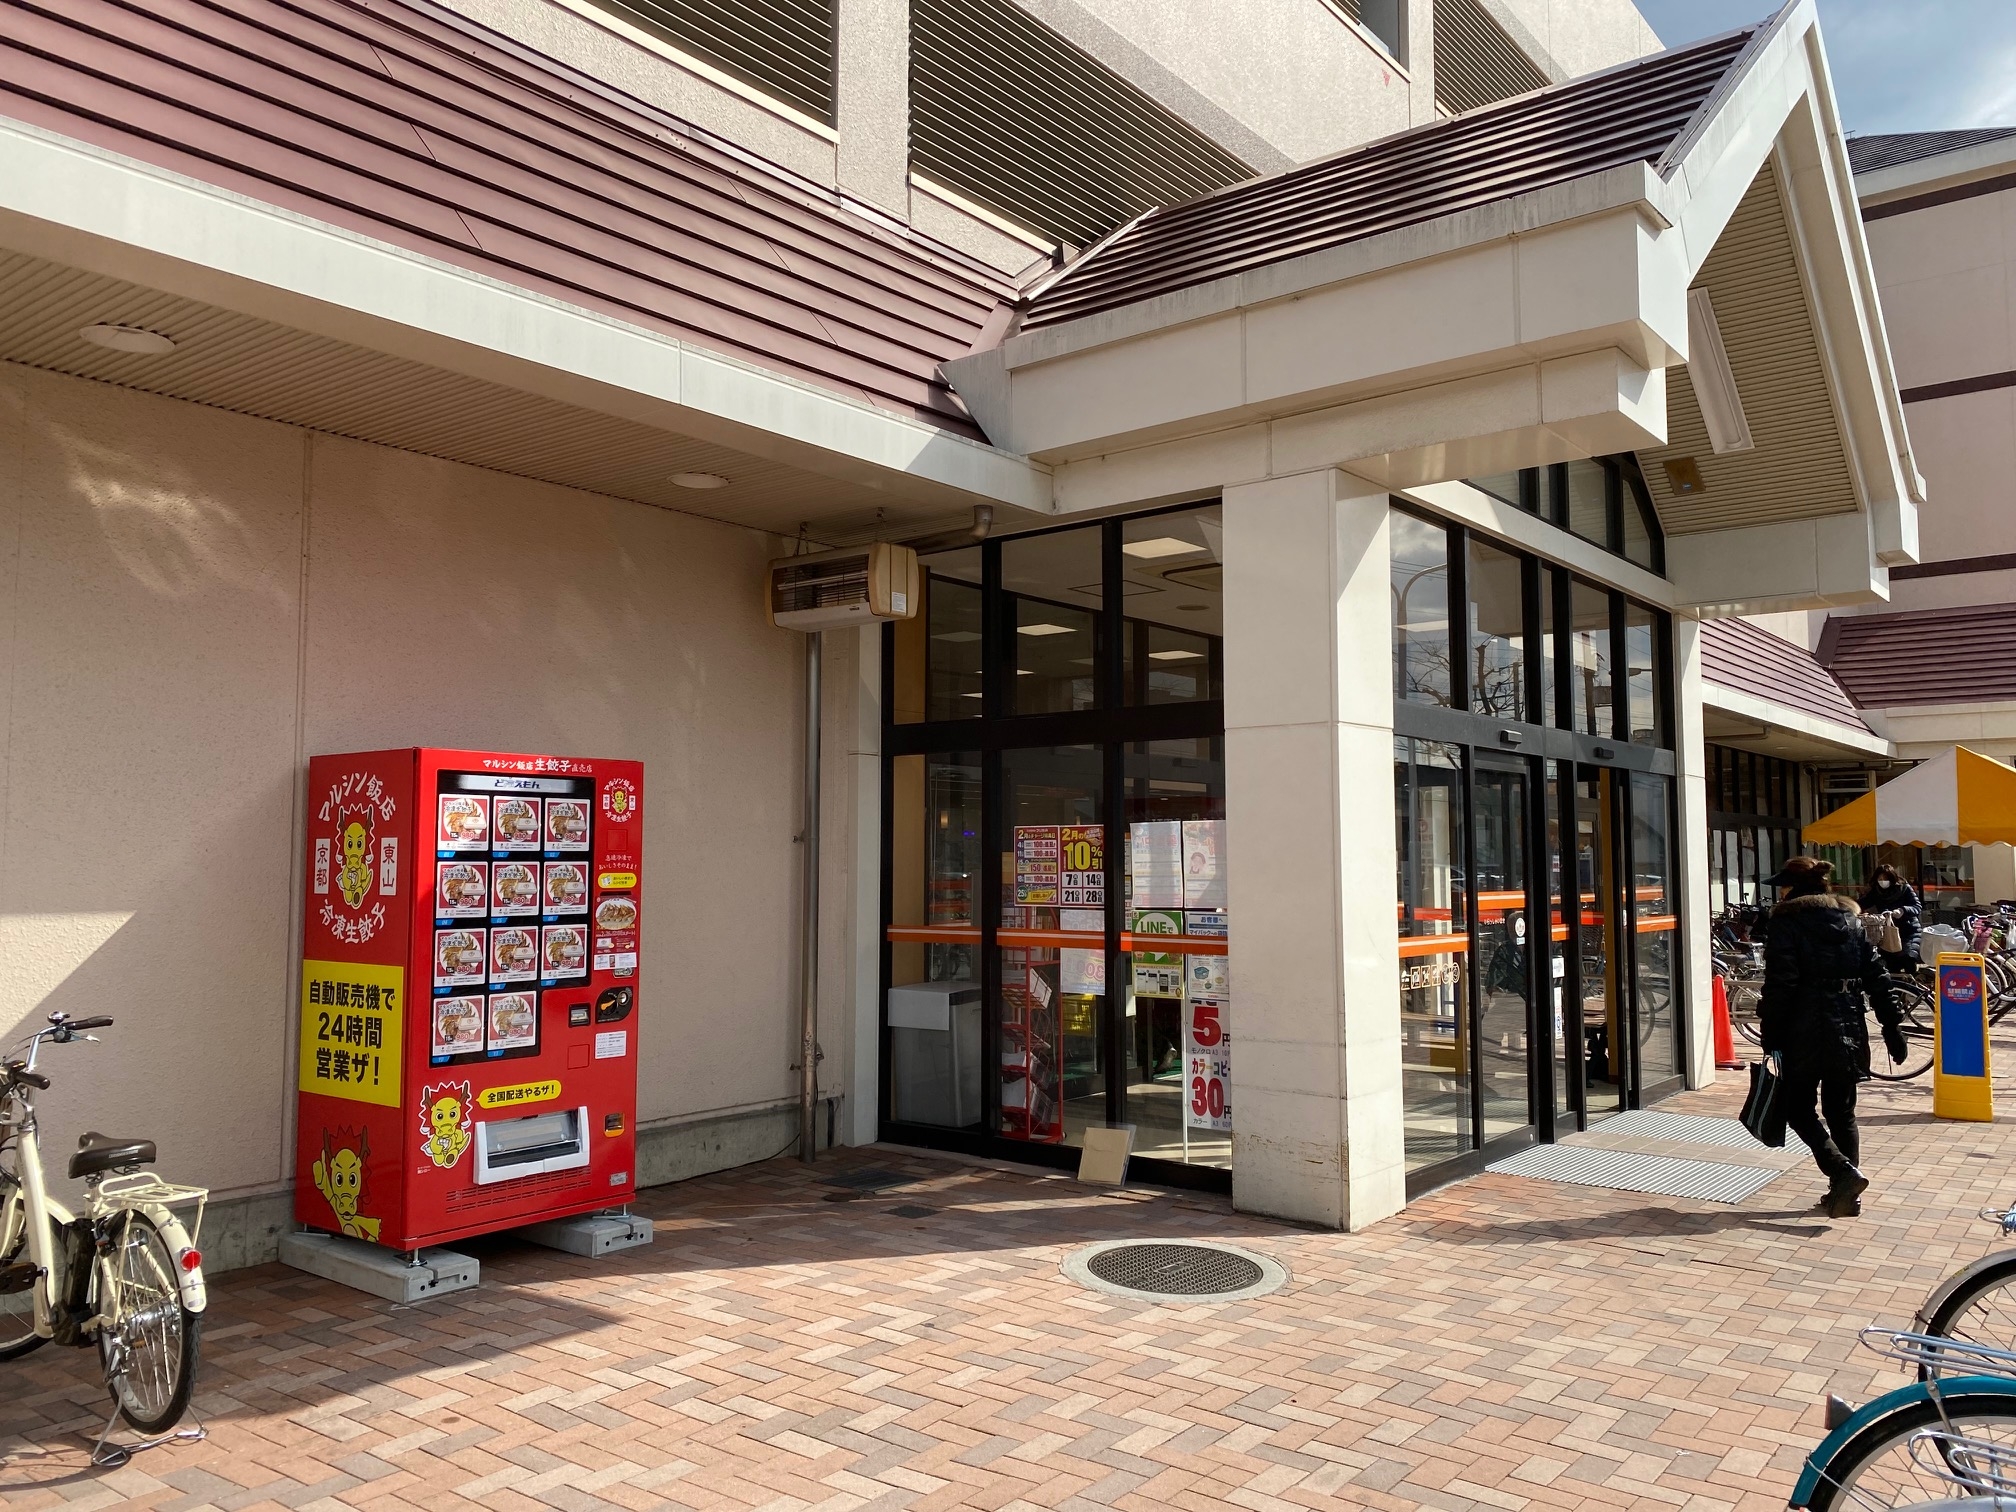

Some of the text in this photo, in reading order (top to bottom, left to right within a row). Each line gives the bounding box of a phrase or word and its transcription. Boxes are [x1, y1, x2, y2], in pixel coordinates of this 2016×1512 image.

[318, 771, 396, 822] マルシン飯店
[1061, 828, 1084, 841] 2月の
[316, 844, 329, 887] 京都
[383, 843, 395, 887] 東山
[319, 898, 386, 944] 冷凍生餃子
[1140, 921, 1174, 934] LINEで
[309, 979, 395, 1011] 自動販売機で
[317, 1012, 382, 1049] 24時間
[316, 1047, 380, 1085] 営業ザ！
[1191, 1047, 1211, 1055] モノクロ
[1192, 1058, 1230, 1077] カラーコピ
[487, 1084, 555, 1103] 全国配送やるザ！
